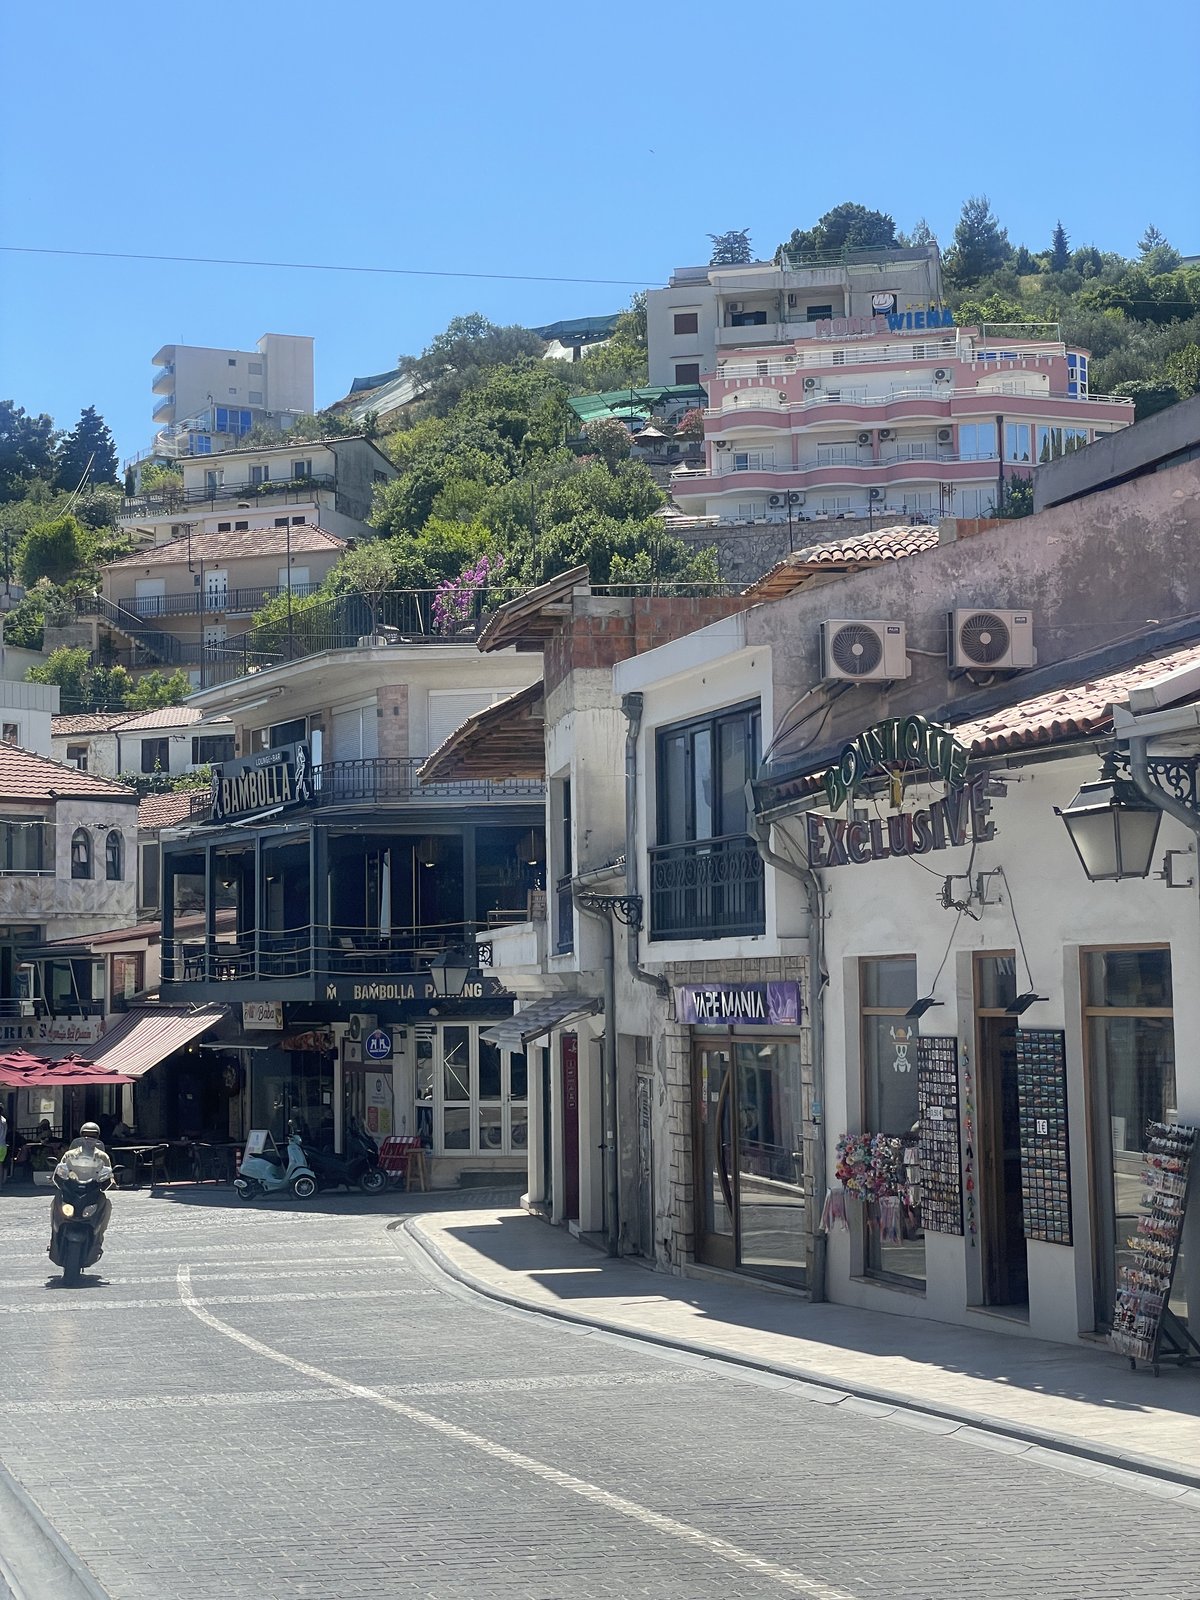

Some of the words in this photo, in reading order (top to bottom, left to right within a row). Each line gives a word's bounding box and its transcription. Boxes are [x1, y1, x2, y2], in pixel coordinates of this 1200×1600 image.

[816, 315, 886, 337] MONTE
[223, 763, 291, 815] BAMBOLLA
[806, 770, 996, 870] EXCLUSIVE
[354, 982, 415, 1000] BAMBOLLA
[257, 1005, 275, 1021] Baba
[692, 991, 720, 1018] VAPE
[721, 991, 765, 1018] MANIA
[1037, 1120, 1046, 1134] 1€
